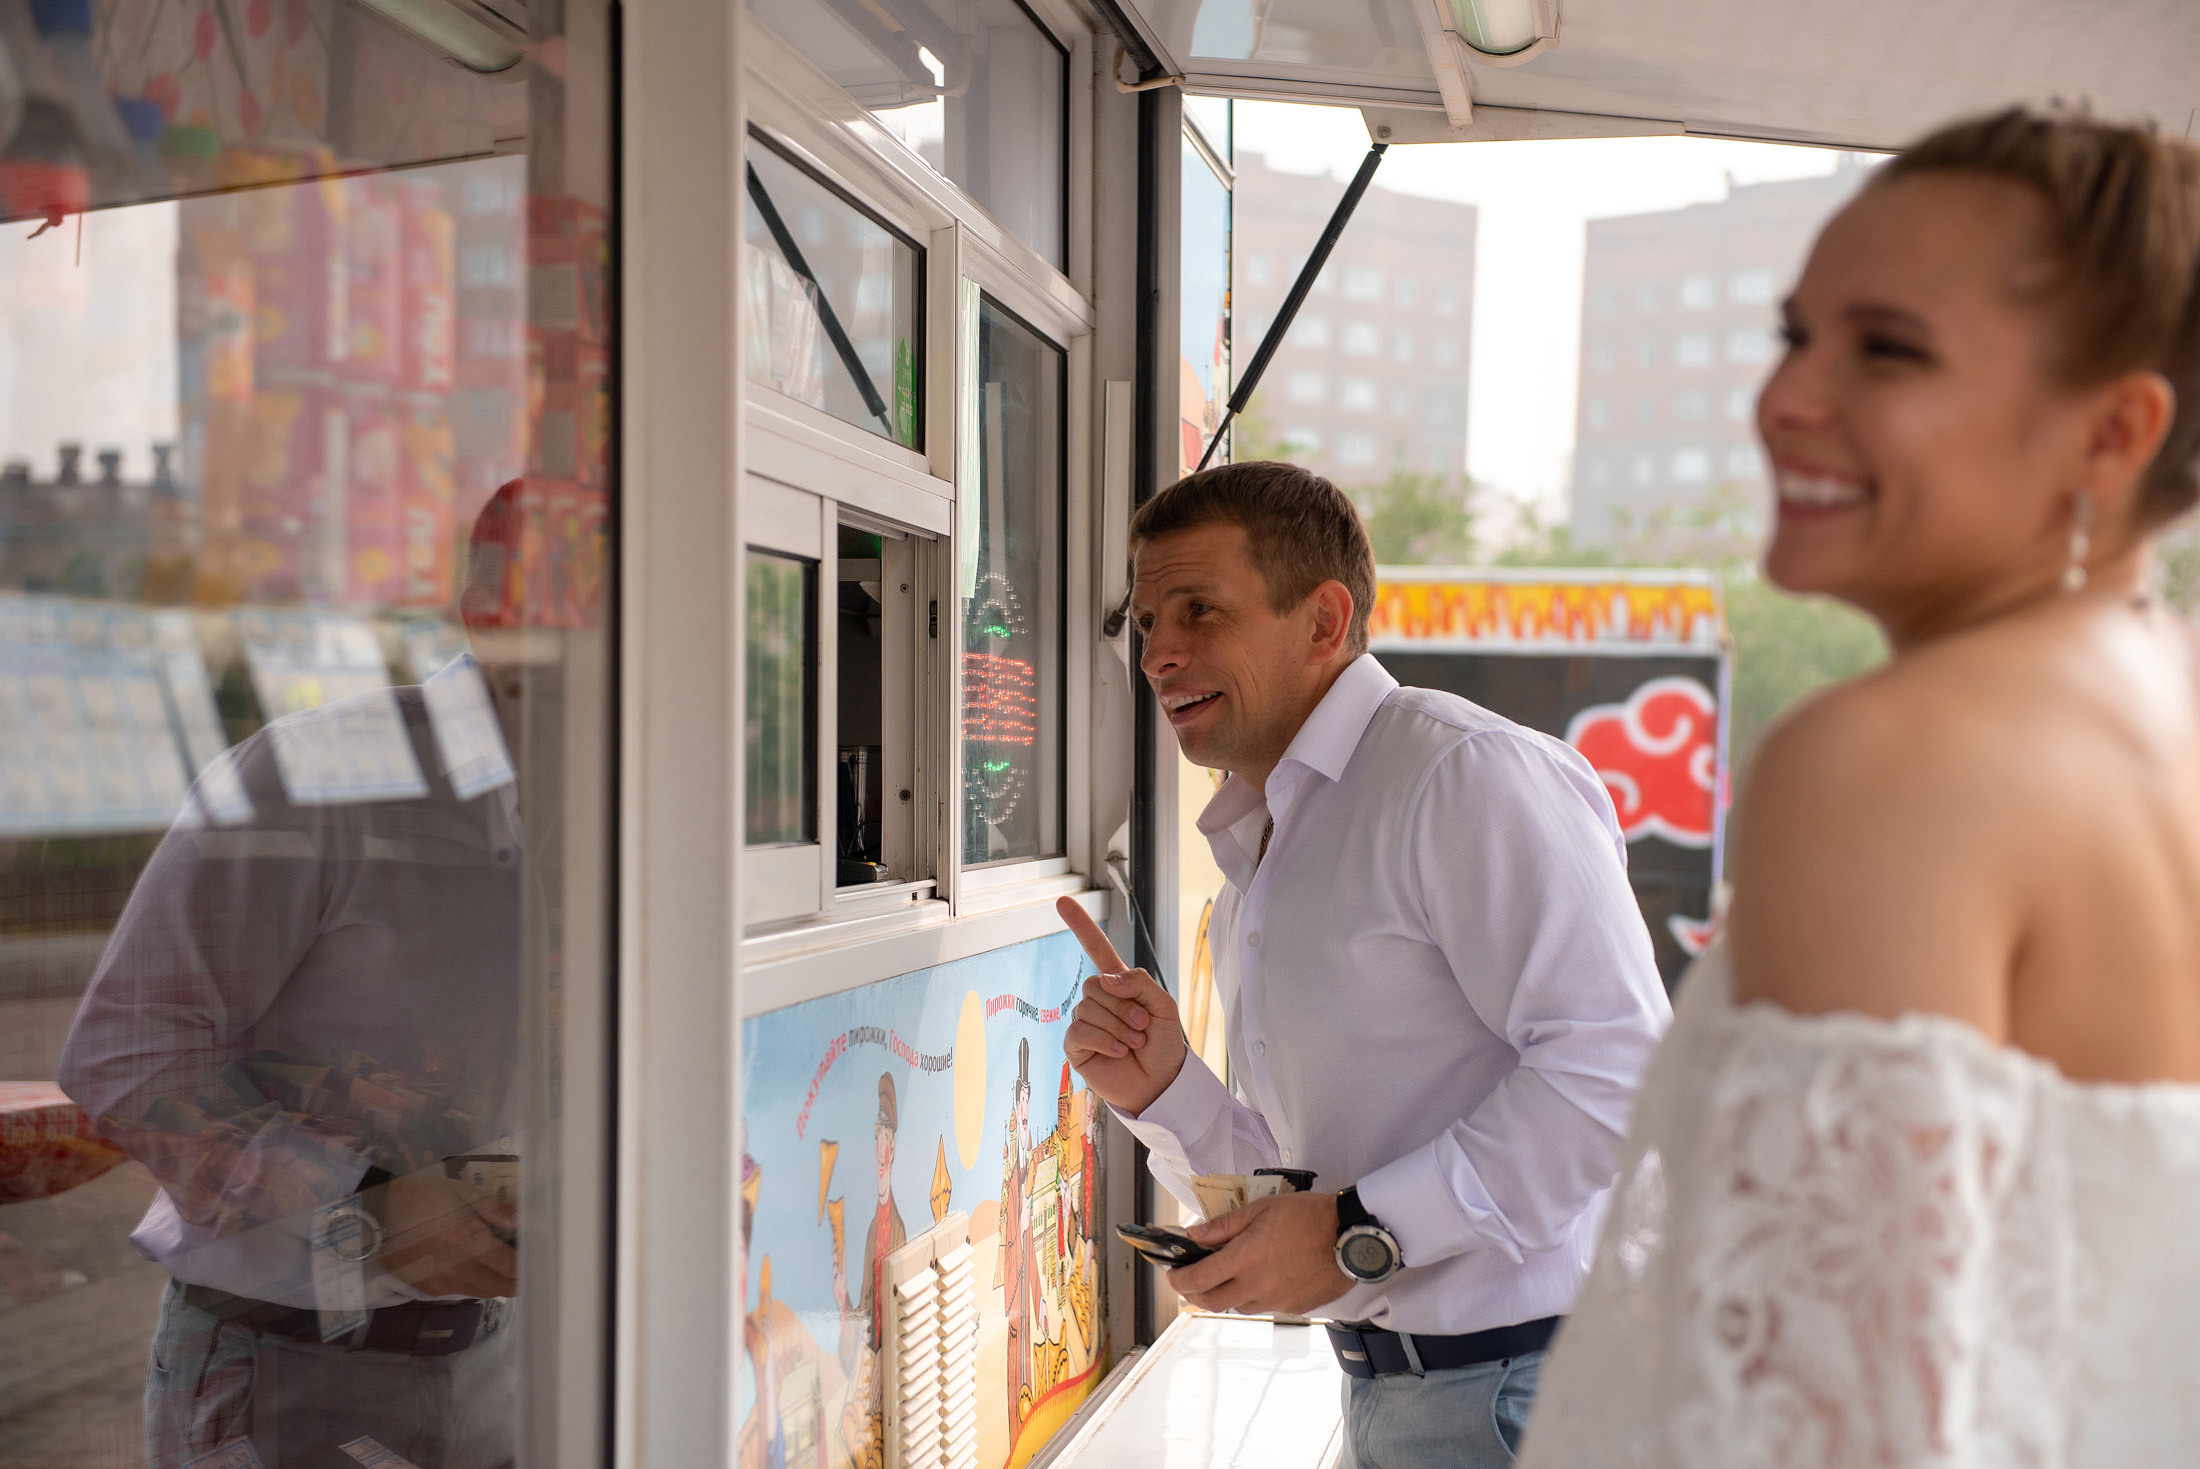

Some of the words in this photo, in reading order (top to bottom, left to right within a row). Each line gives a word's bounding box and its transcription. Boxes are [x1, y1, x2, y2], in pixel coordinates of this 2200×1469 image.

[985, 993, 1016, 1021] Пирожки
[1016, 997, 1039, 1024] горячие,
[1040, 1006, 1061, 1023] свежие,
[796, 1032, 848, 1140] Покупайте
[848, 1025, 888, 1050] пирожки,
[888, 1028, 919, 1069] Господа
[919, 1046, 953, 1076] хорошие!
